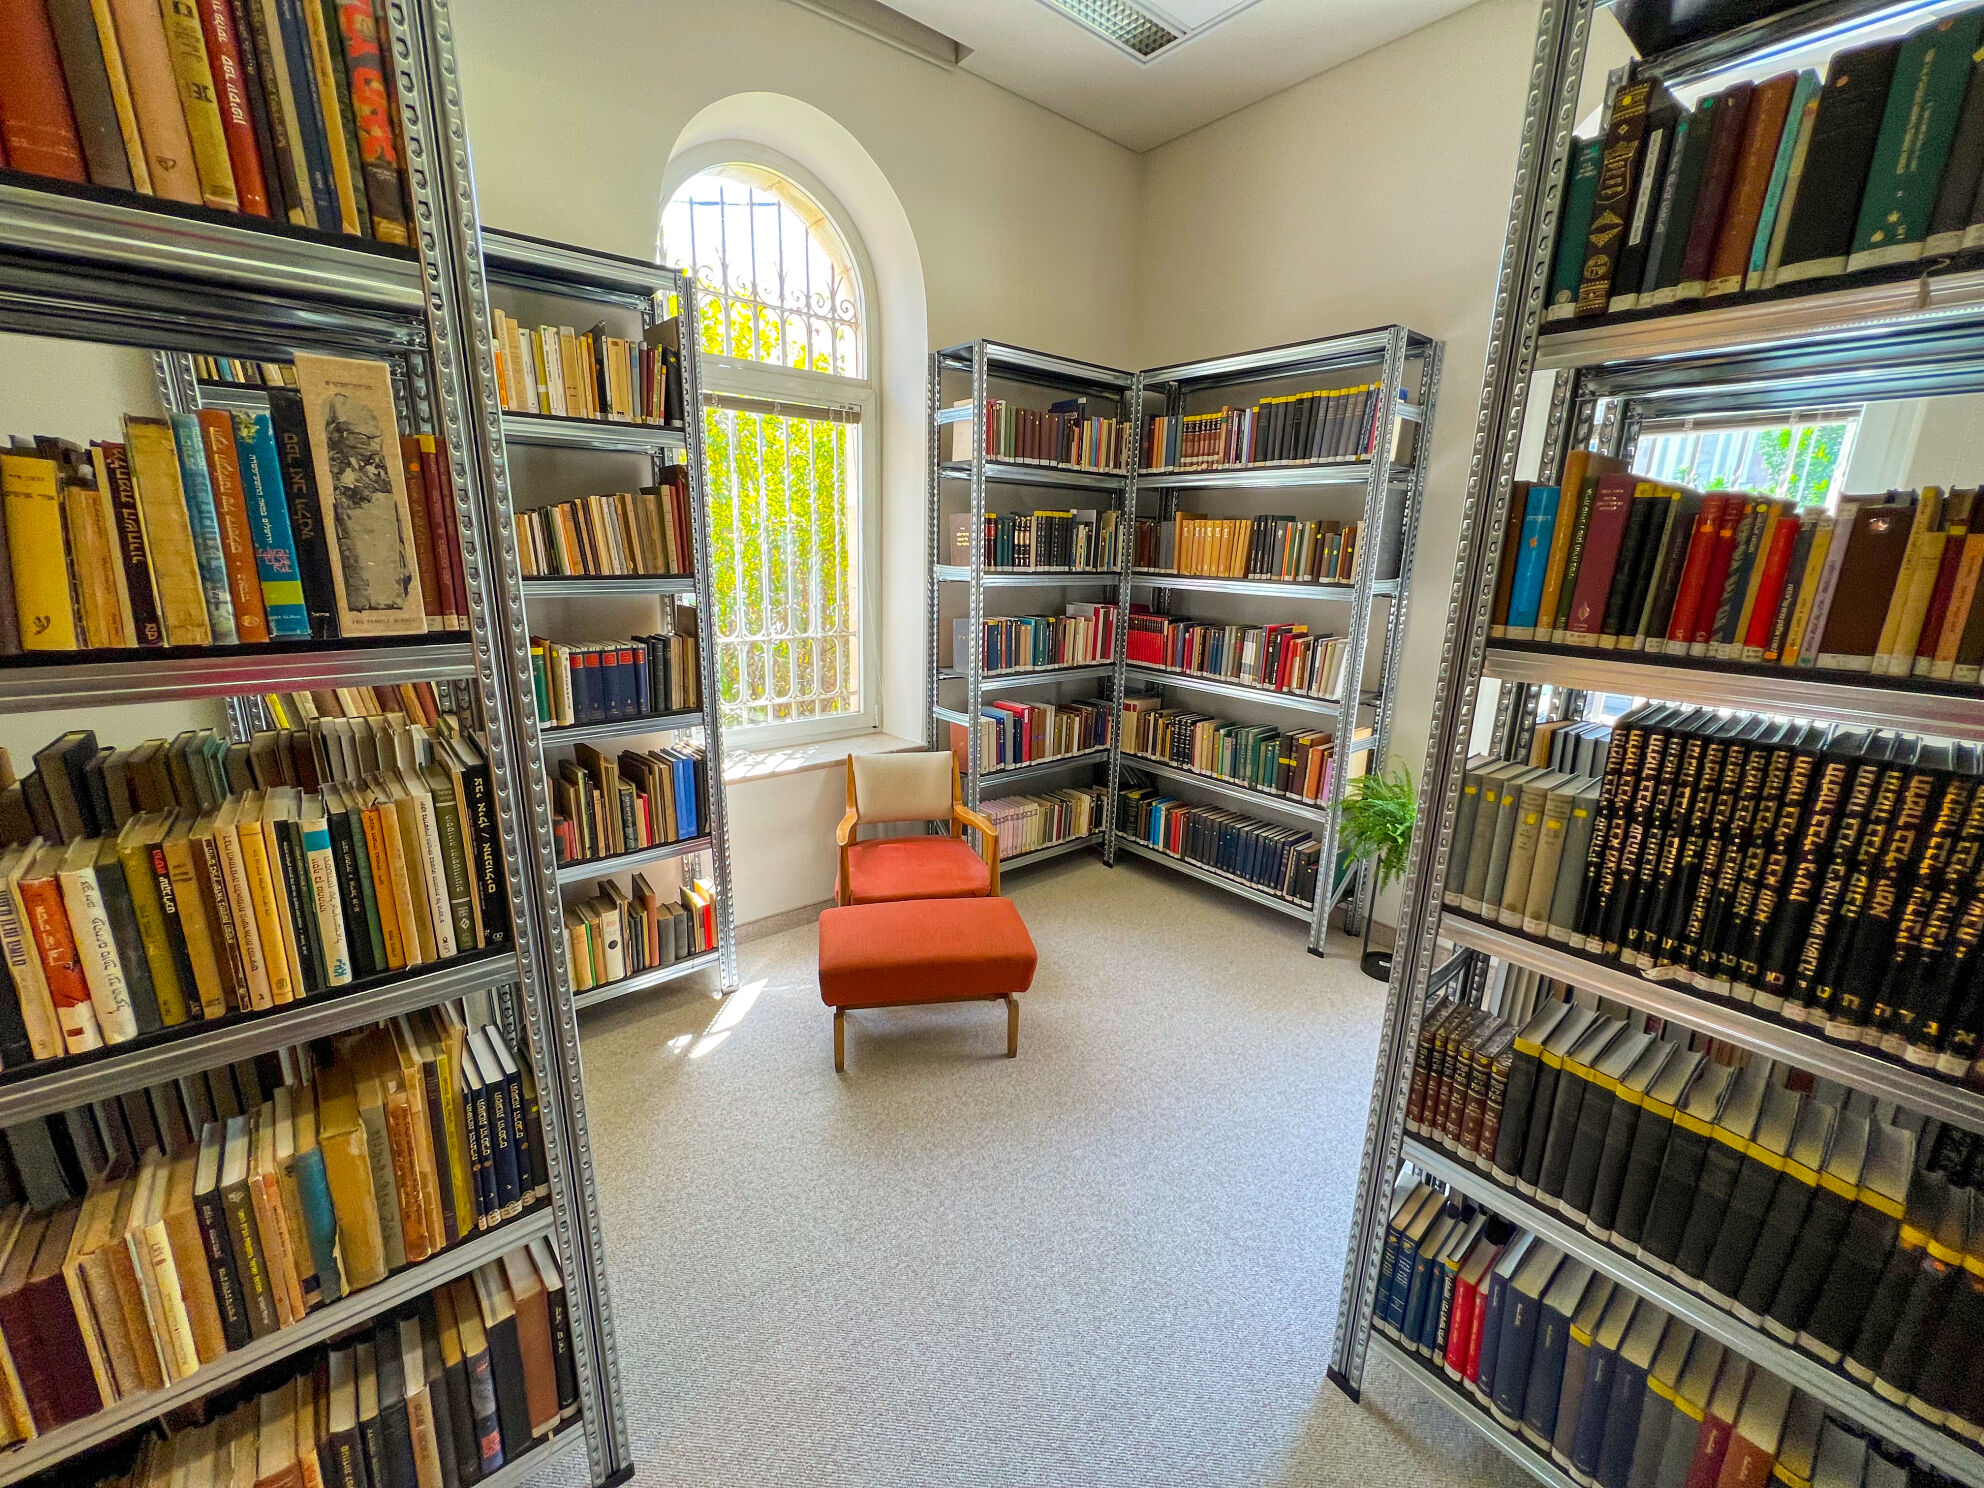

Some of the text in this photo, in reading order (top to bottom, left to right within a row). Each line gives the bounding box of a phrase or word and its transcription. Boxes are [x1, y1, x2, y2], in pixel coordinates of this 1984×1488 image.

[219, 53, 236, 81] ספר
[223, 82, 246, 127] יוסיפון
[104, 446, 146, 564] מלחמת השחרור
[218, 493, 235, 512] של
[281, 431, 316, 540] ספר זאב וילנאי
[221, 513, 243, 554] ירושלים
[473, 777, 484, 798] צבי
[1696, 742, 1725, 791] תלמוד
[1718, 743, 1747, 794] תלמוד
[1740, 748, 1768, 799] תלמוד
[1846, 762, 1879, 814] תלמוד
[419, 800, 427, 813] יעקב
[475, 802, 489, 828] אילן
[1587, 727, 1628, 863] תלמוד בבלי סנהדרין
[1597, 728, 1645, 894] תלמוד בבלי בבא מציעא
[1619, 732, 1664, 871] תלמוד בבלי סנהדרין
[1657, 737, 1703, 875] תלמוד בבלי יבמות
[1689, 788, 1714, 828] בבלי
[1710, 791, 1734, 831] בבלי
[1730, 796, 1755, 836] בבלי
[1932, 778, 1970, 837] תלמוד
[221, 834, 235, 851] דברי
[445, 814, 457, 847] היסטוריה
[1732, 748, 1787, 915] תלמוד בבלי בבא קמא
[1755, 753, 1813, 923] תלמוד בבלי בבא קמא
[1787, 760, 1847, 903] תלמוד בבלי גיטין
[1832, 813, 1861, 856] בבלי
[1839, 767, 1905, 919] תלמוד בבלי סוכה
[1867, 770, 1935, 920] תלמוד בבלי יומא
[480, 841, 496, 893] אתמולים
[1917, 831, 1951, 880] בבלי
[1944, 838, 1974, 883] בבלי
[310, 857, 327, 913] יוסף בן מתתיהו
[325, 891, 337, 902] של
[1808, 902, 1833, 936] ראש
[1795, 935, 1824, 976] השנה
[475, 1098, 487, 1125] תשובות
[492, 1091, 505, 1118] תשובות
[509, 1082, 520, 1108] תשובות
